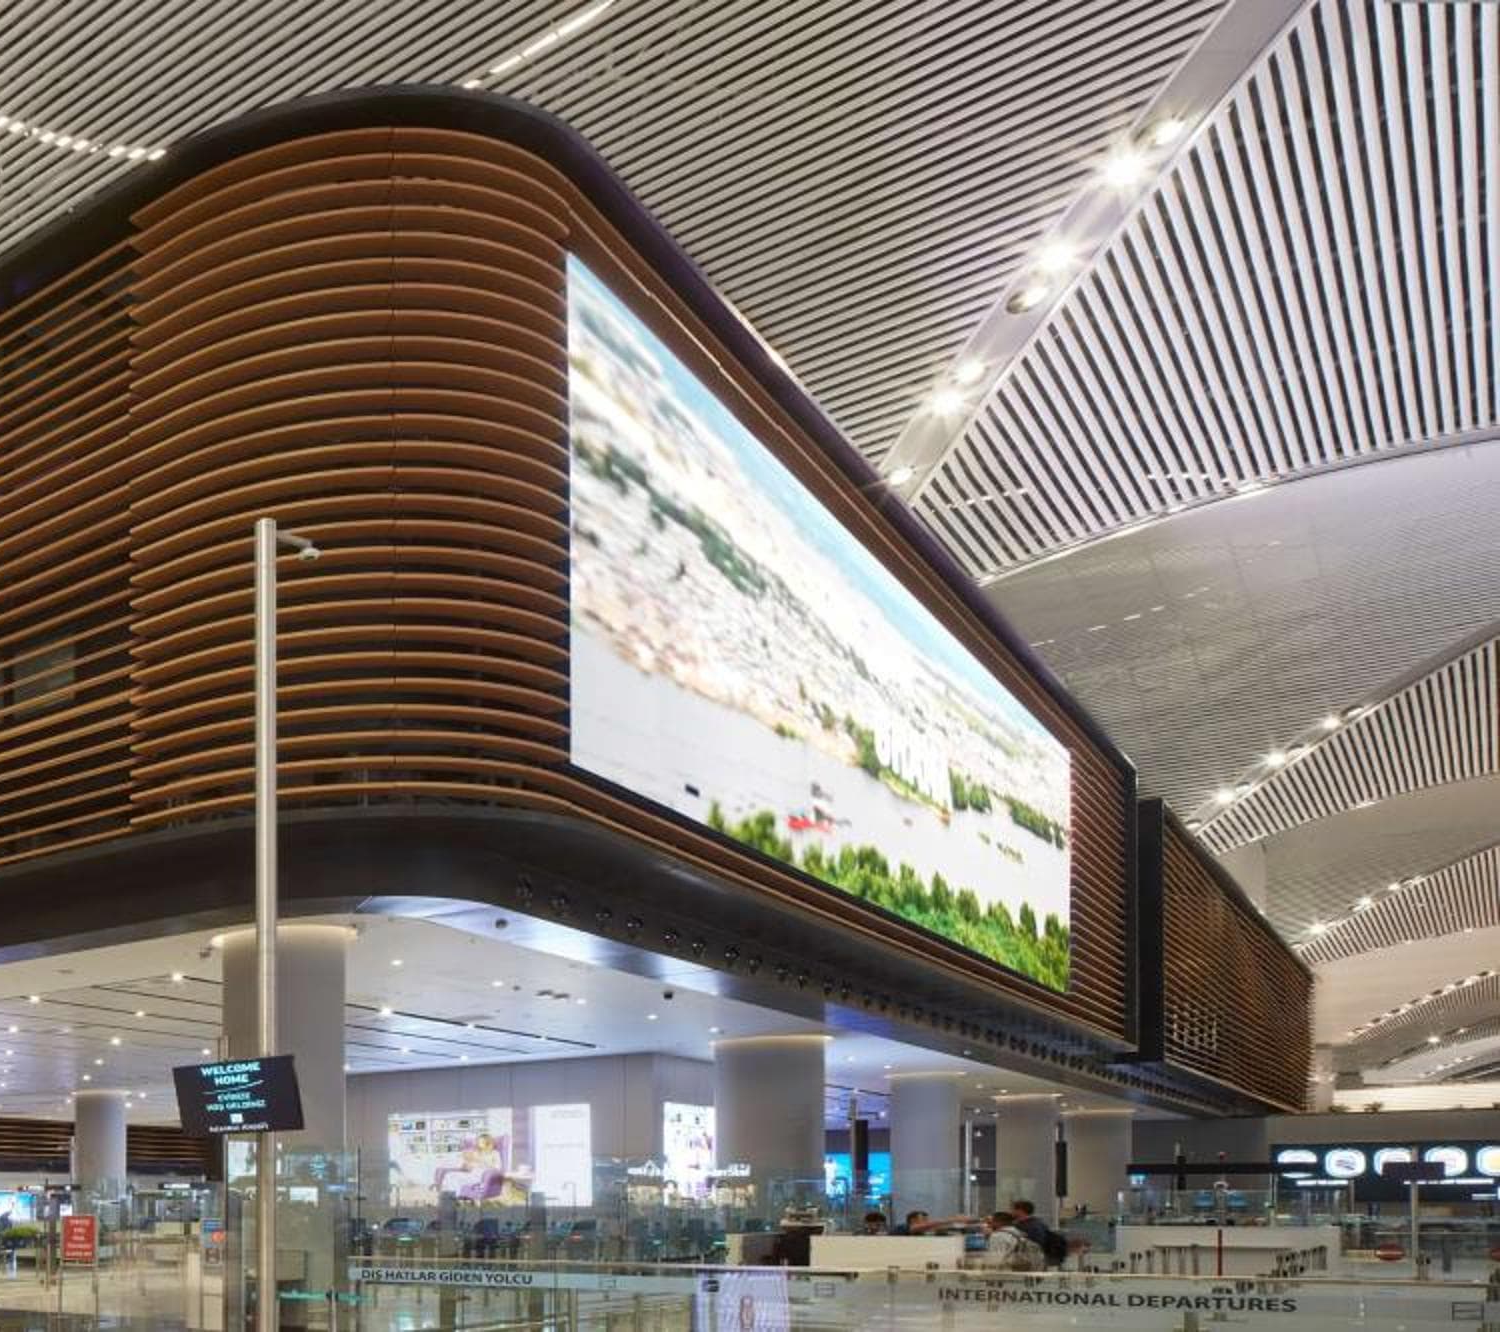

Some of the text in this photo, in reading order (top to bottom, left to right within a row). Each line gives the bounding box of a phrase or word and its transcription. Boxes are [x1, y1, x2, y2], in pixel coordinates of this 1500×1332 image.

[201, 1061, 260, 1076] WELCOME
[214, 1073, 249, 1086] HOME
[385, 1269, 436, 1281] HATLAR
[485, 1272, 533, 1285] YOLCU
[938, 1287, 1298, 1313] INTERNATIONAL DEPARTURES
